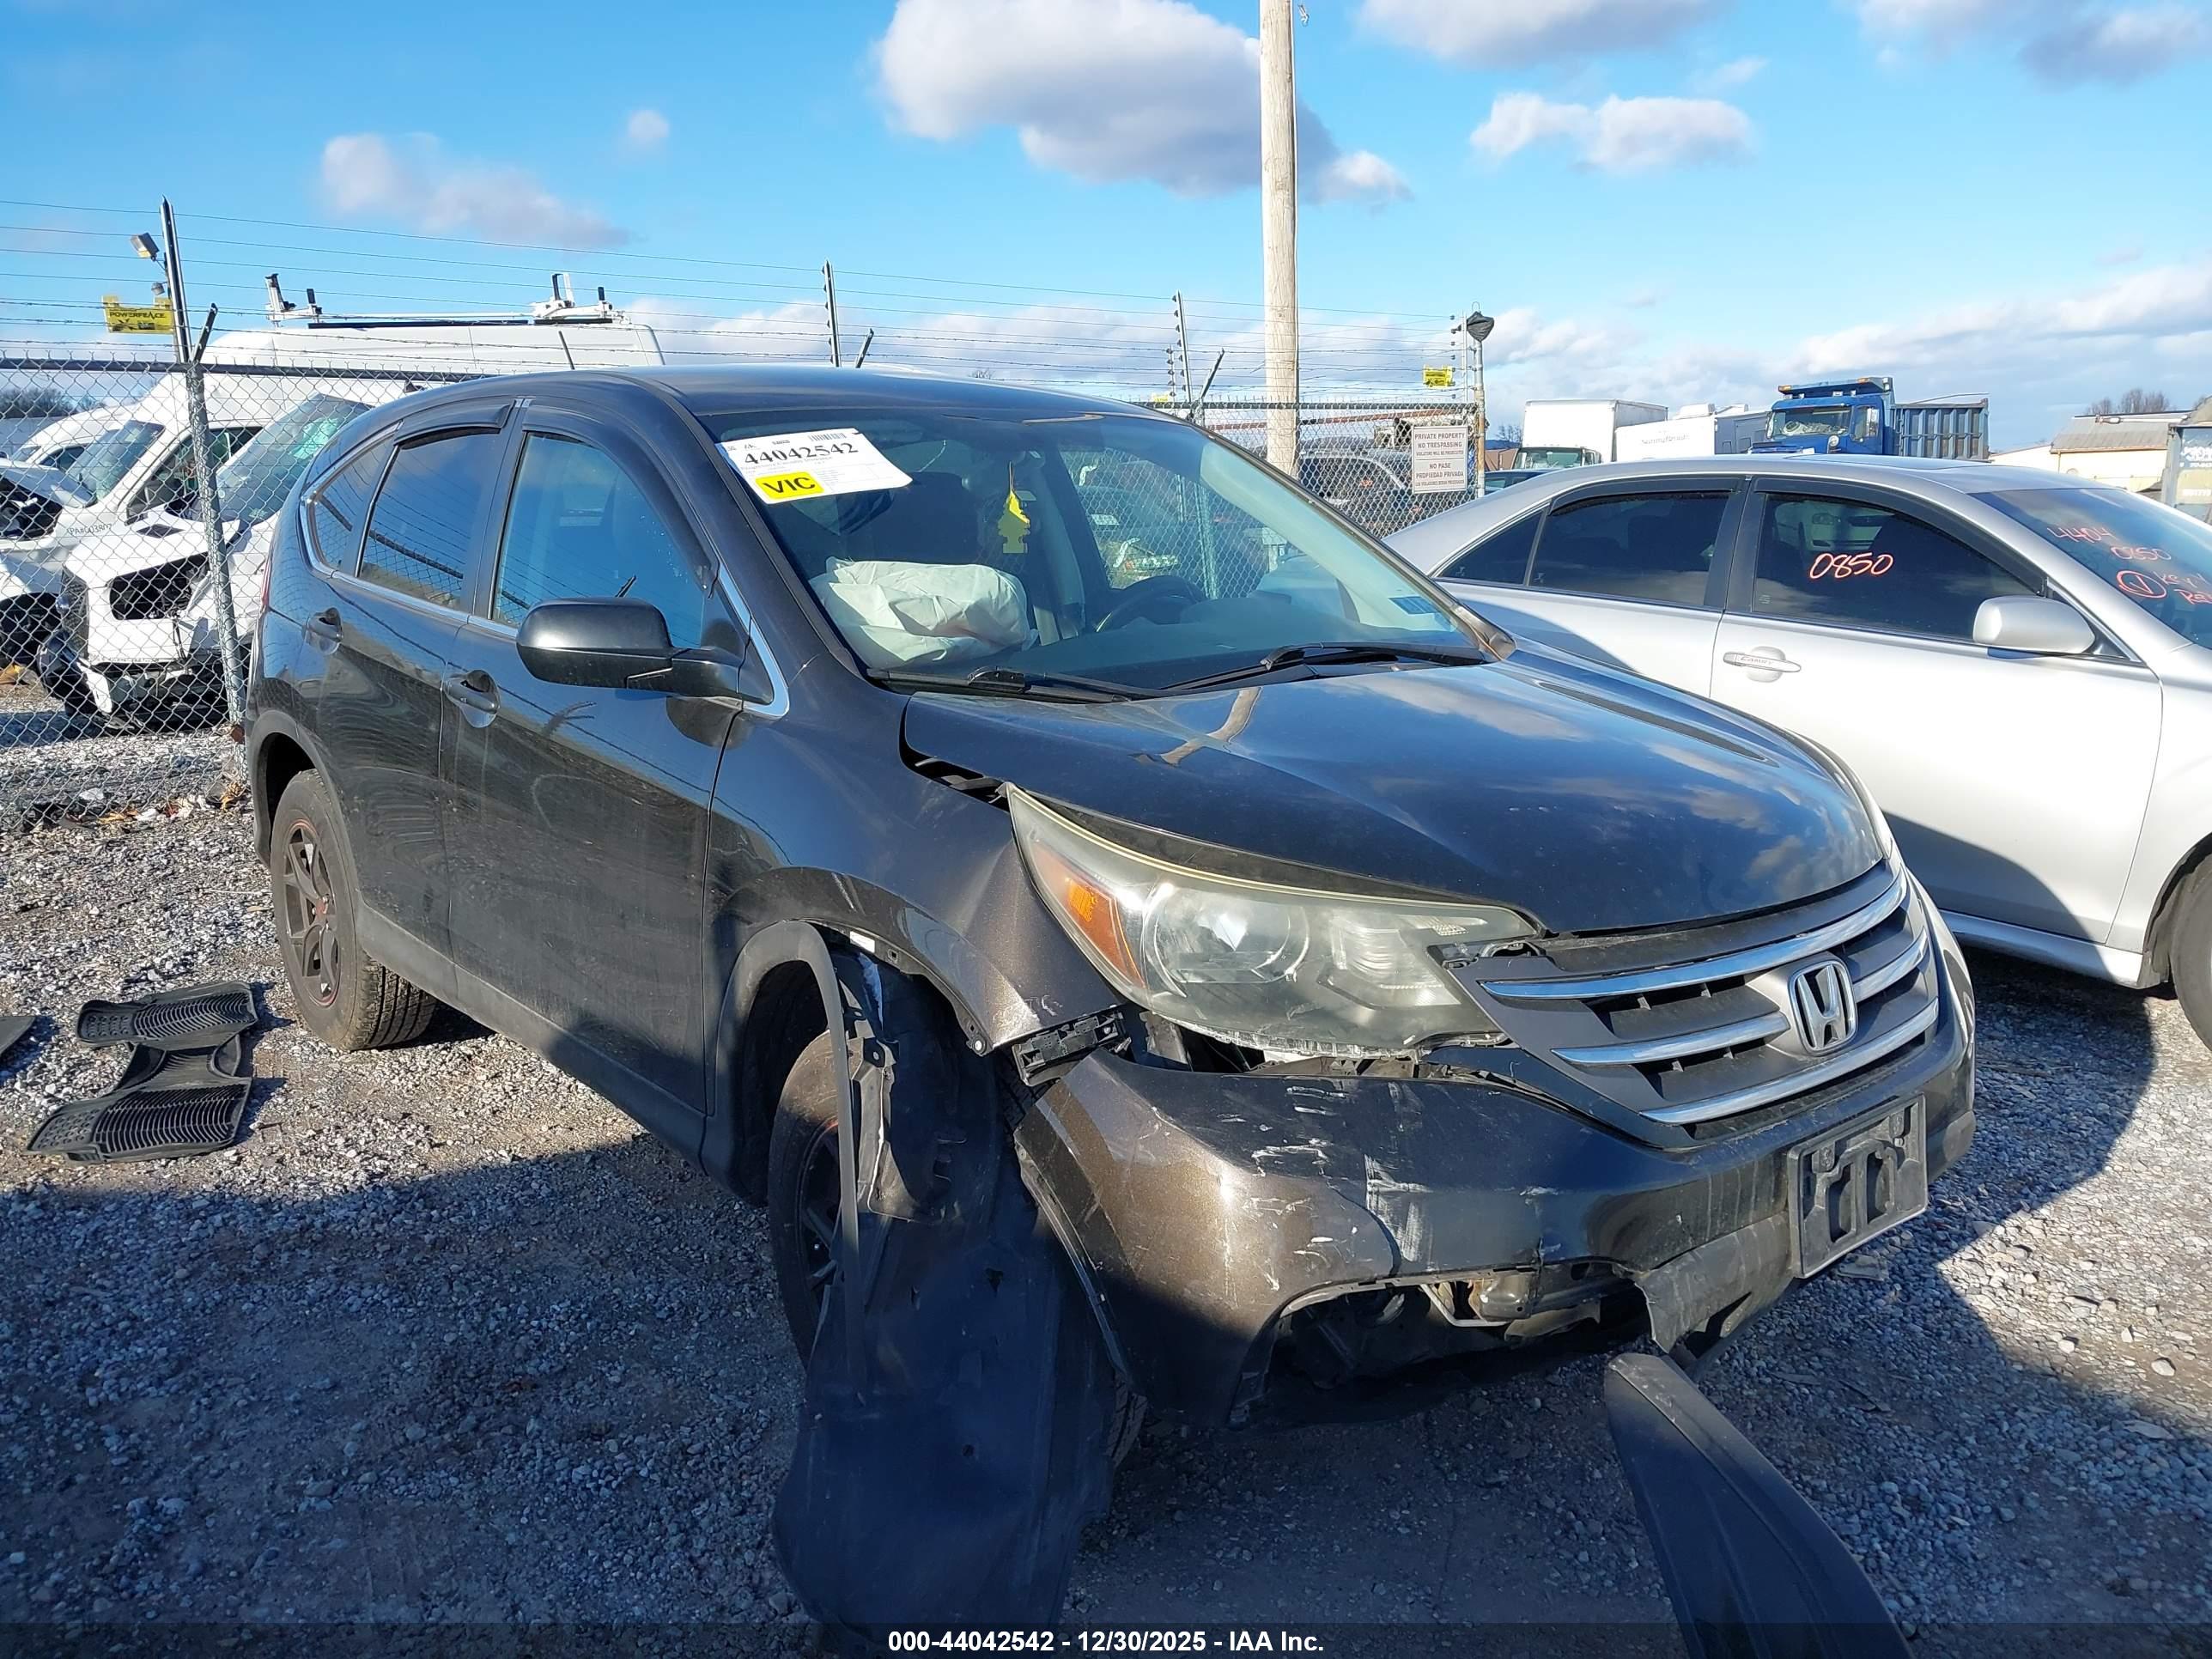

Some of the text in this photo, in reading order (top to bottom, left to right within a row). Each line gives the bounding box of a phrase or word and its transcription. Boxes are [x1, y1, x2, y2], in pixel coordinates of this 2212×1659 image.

[744, 442, 859, 465] 44042542
[763, 477, 816, 494] VIC
[1809, 552, 1893, 580] 0850
